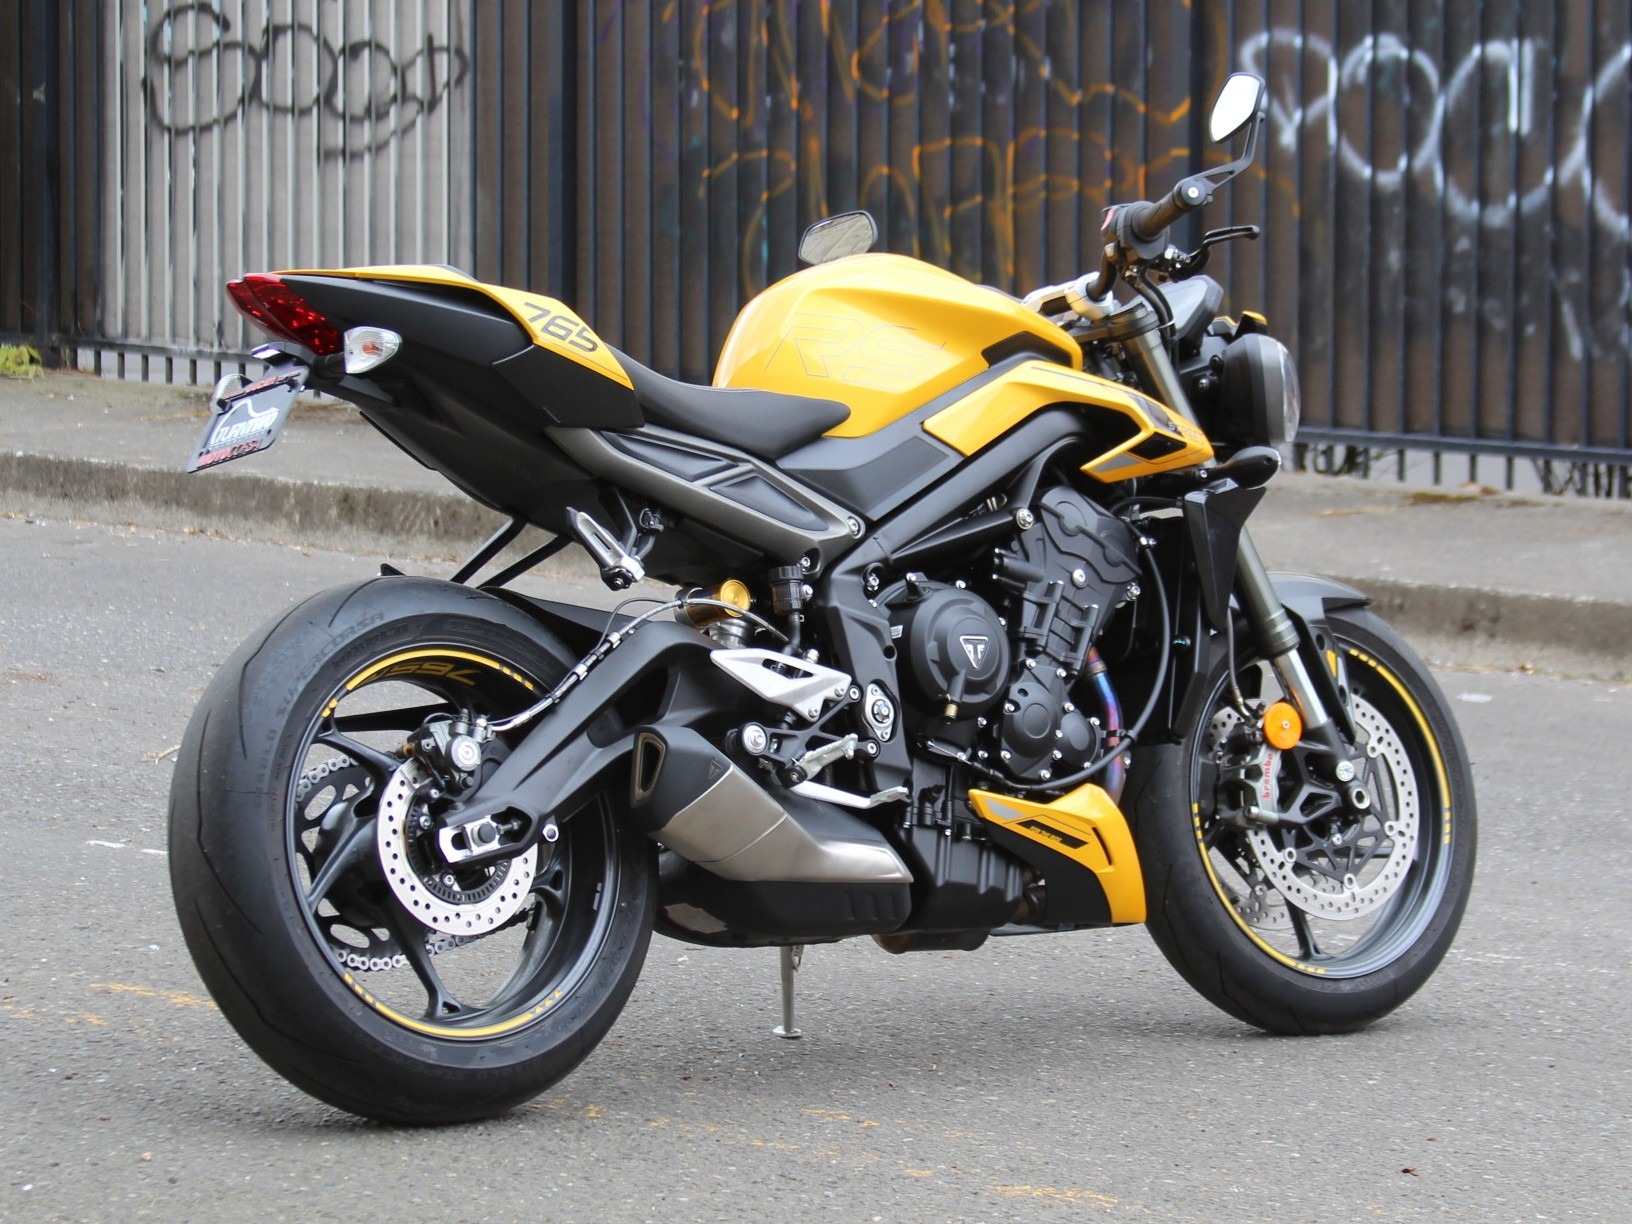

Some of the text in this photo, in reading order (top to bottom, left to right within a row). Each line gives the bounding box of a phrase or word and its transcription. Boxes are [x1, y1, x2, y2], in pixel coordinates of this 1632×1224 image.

[524, 302, 599, 352] 765
[764, 312, 947, 392] RS
[1263, 752, 1274, 799] brembo
